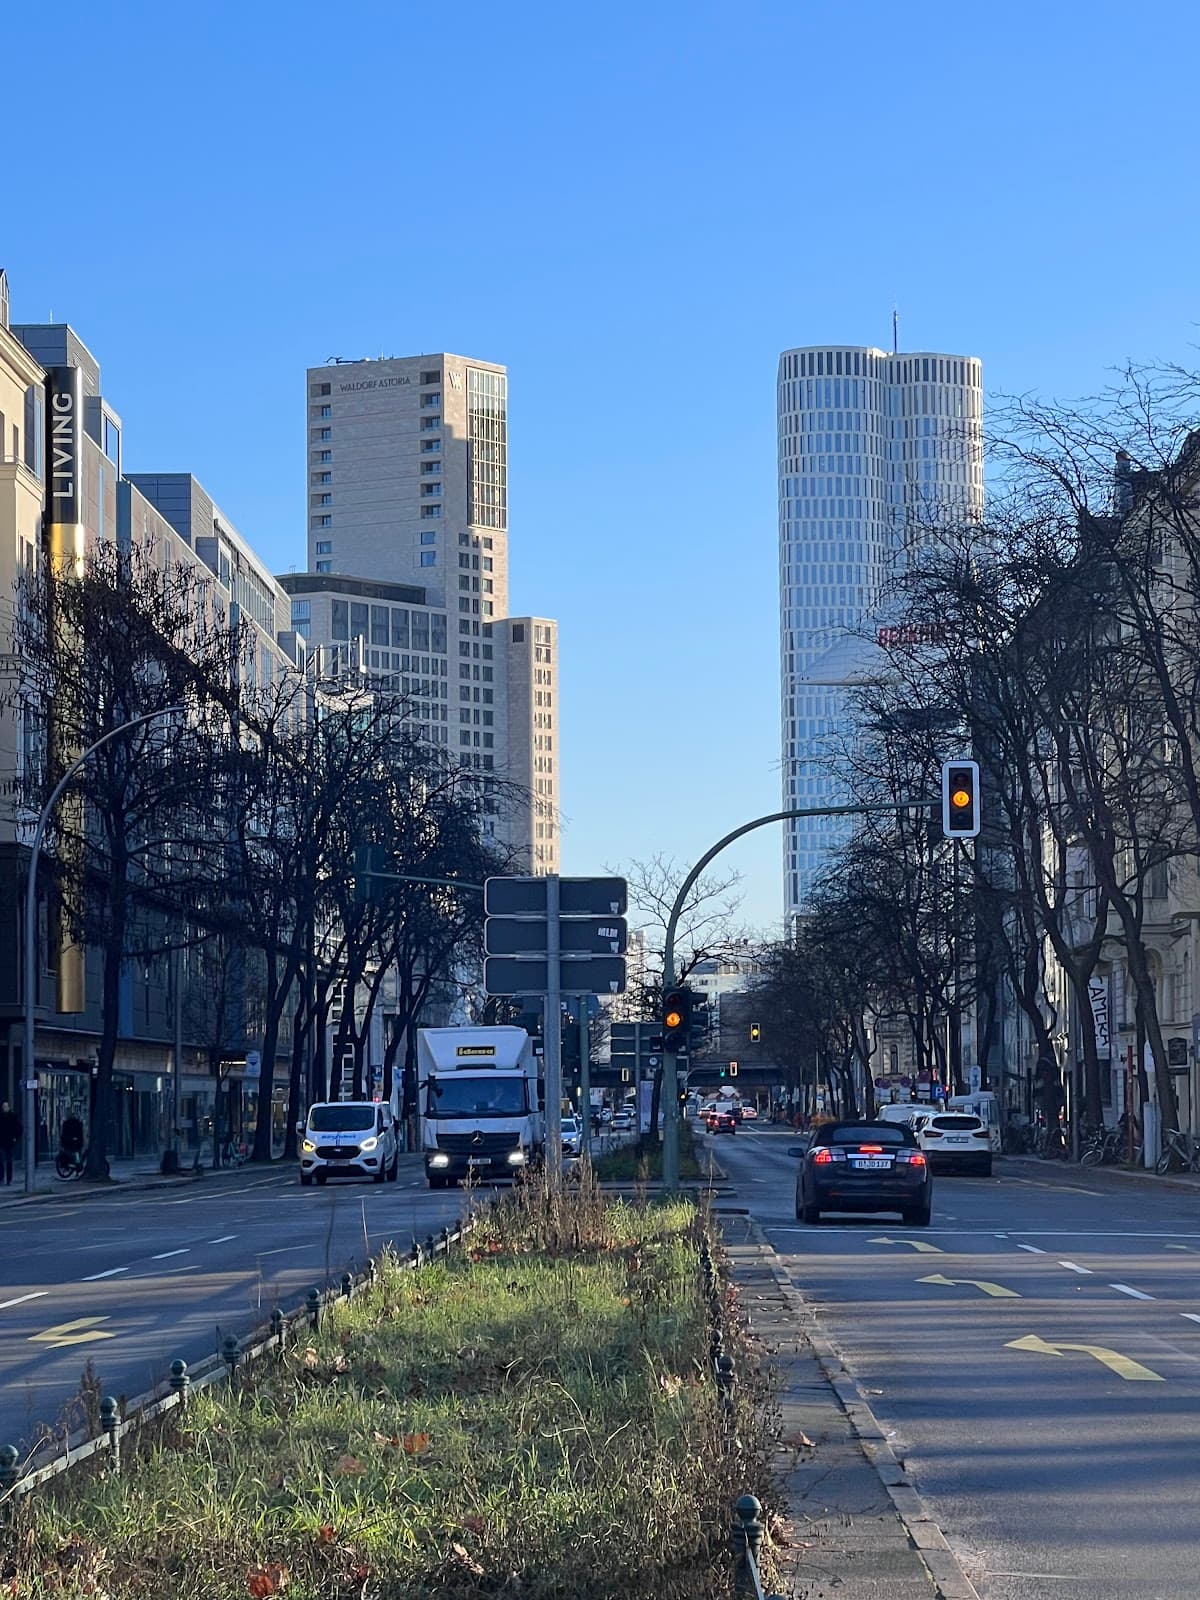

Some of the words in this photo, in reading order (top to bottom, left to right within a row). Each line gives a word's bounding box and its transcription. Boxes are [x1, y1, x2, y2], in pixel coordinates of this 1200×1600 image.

[340, 380, 378, 392] WALDORF
[378, 376, 411, 388] ASTORIA
[53, 393, 73, 498] LIVING
